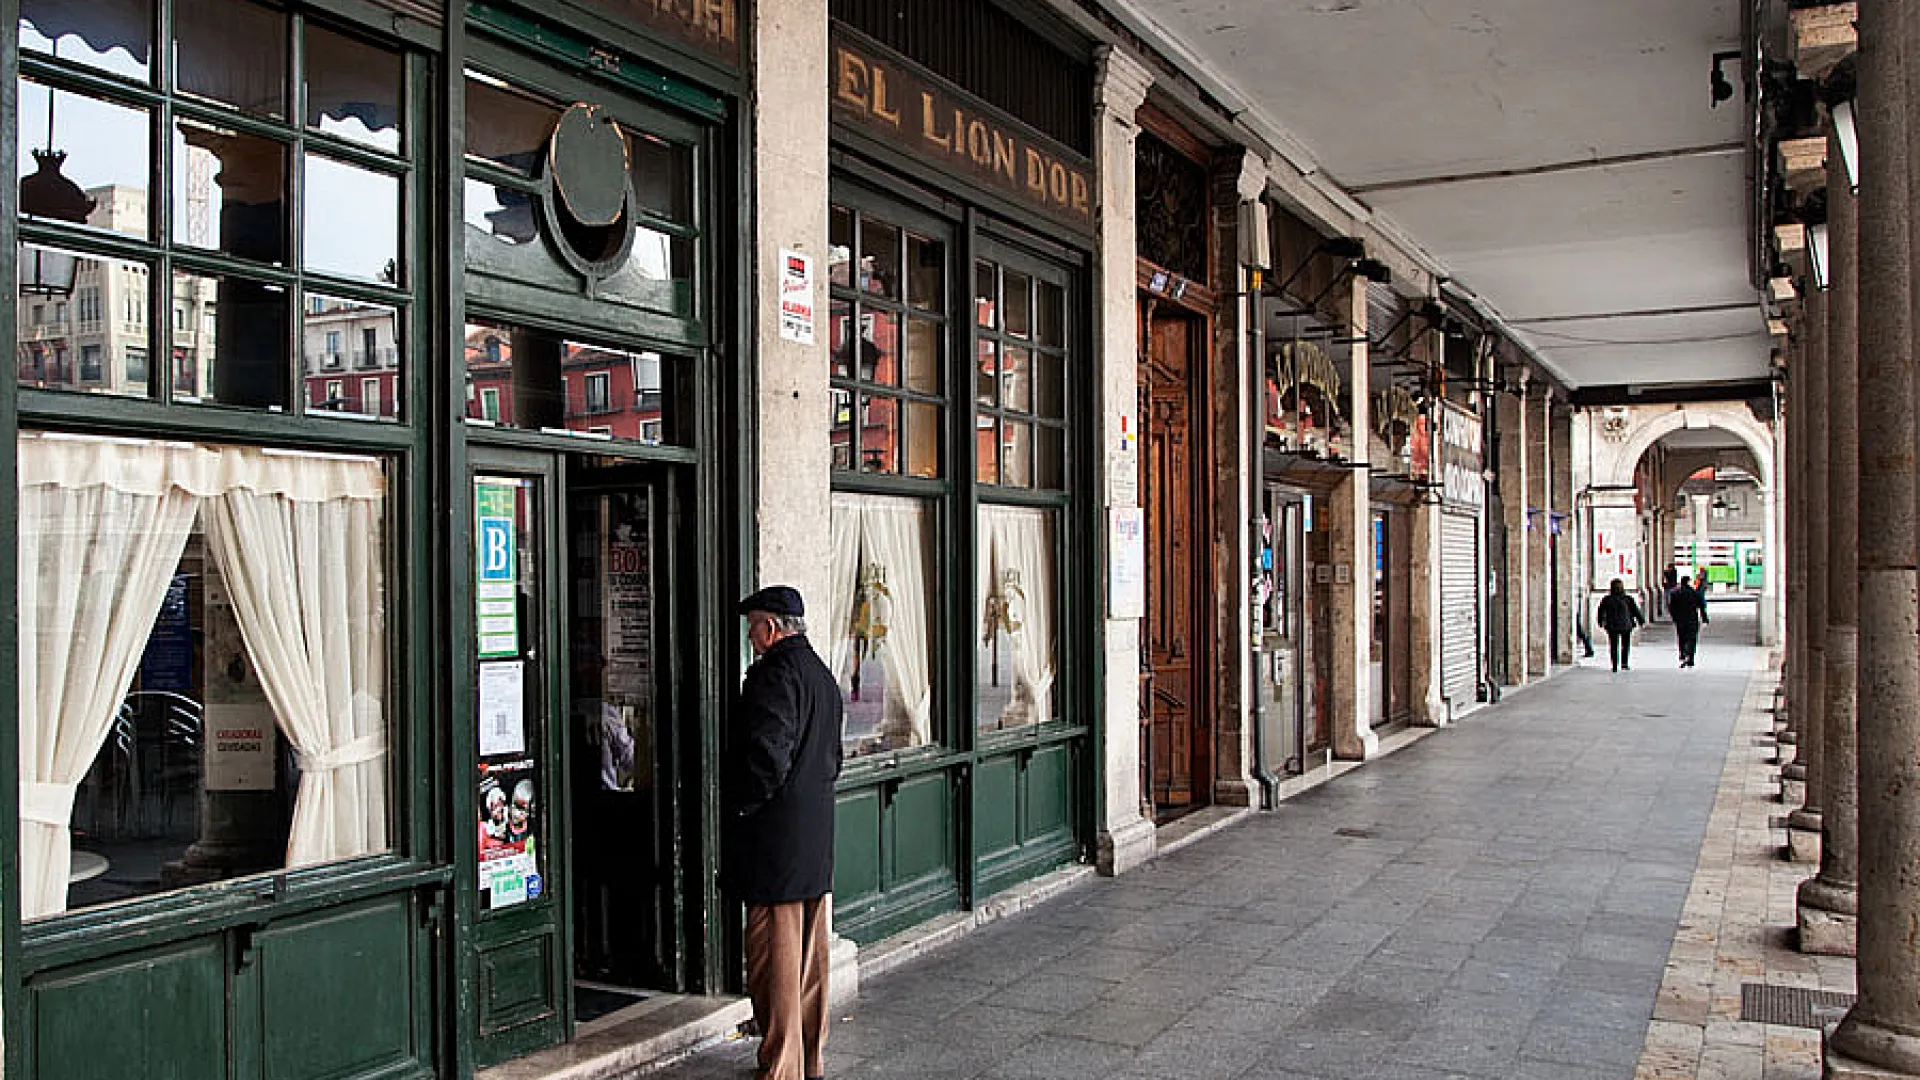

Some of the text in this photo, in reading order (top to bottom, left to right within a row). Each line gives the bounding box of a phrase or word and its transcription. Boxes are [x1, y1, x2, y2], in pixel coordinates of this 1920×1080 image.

[837, 49, 899, 126] EL
[922, 91, 1015, 183] LION
[486, 526, 507, 571] B
